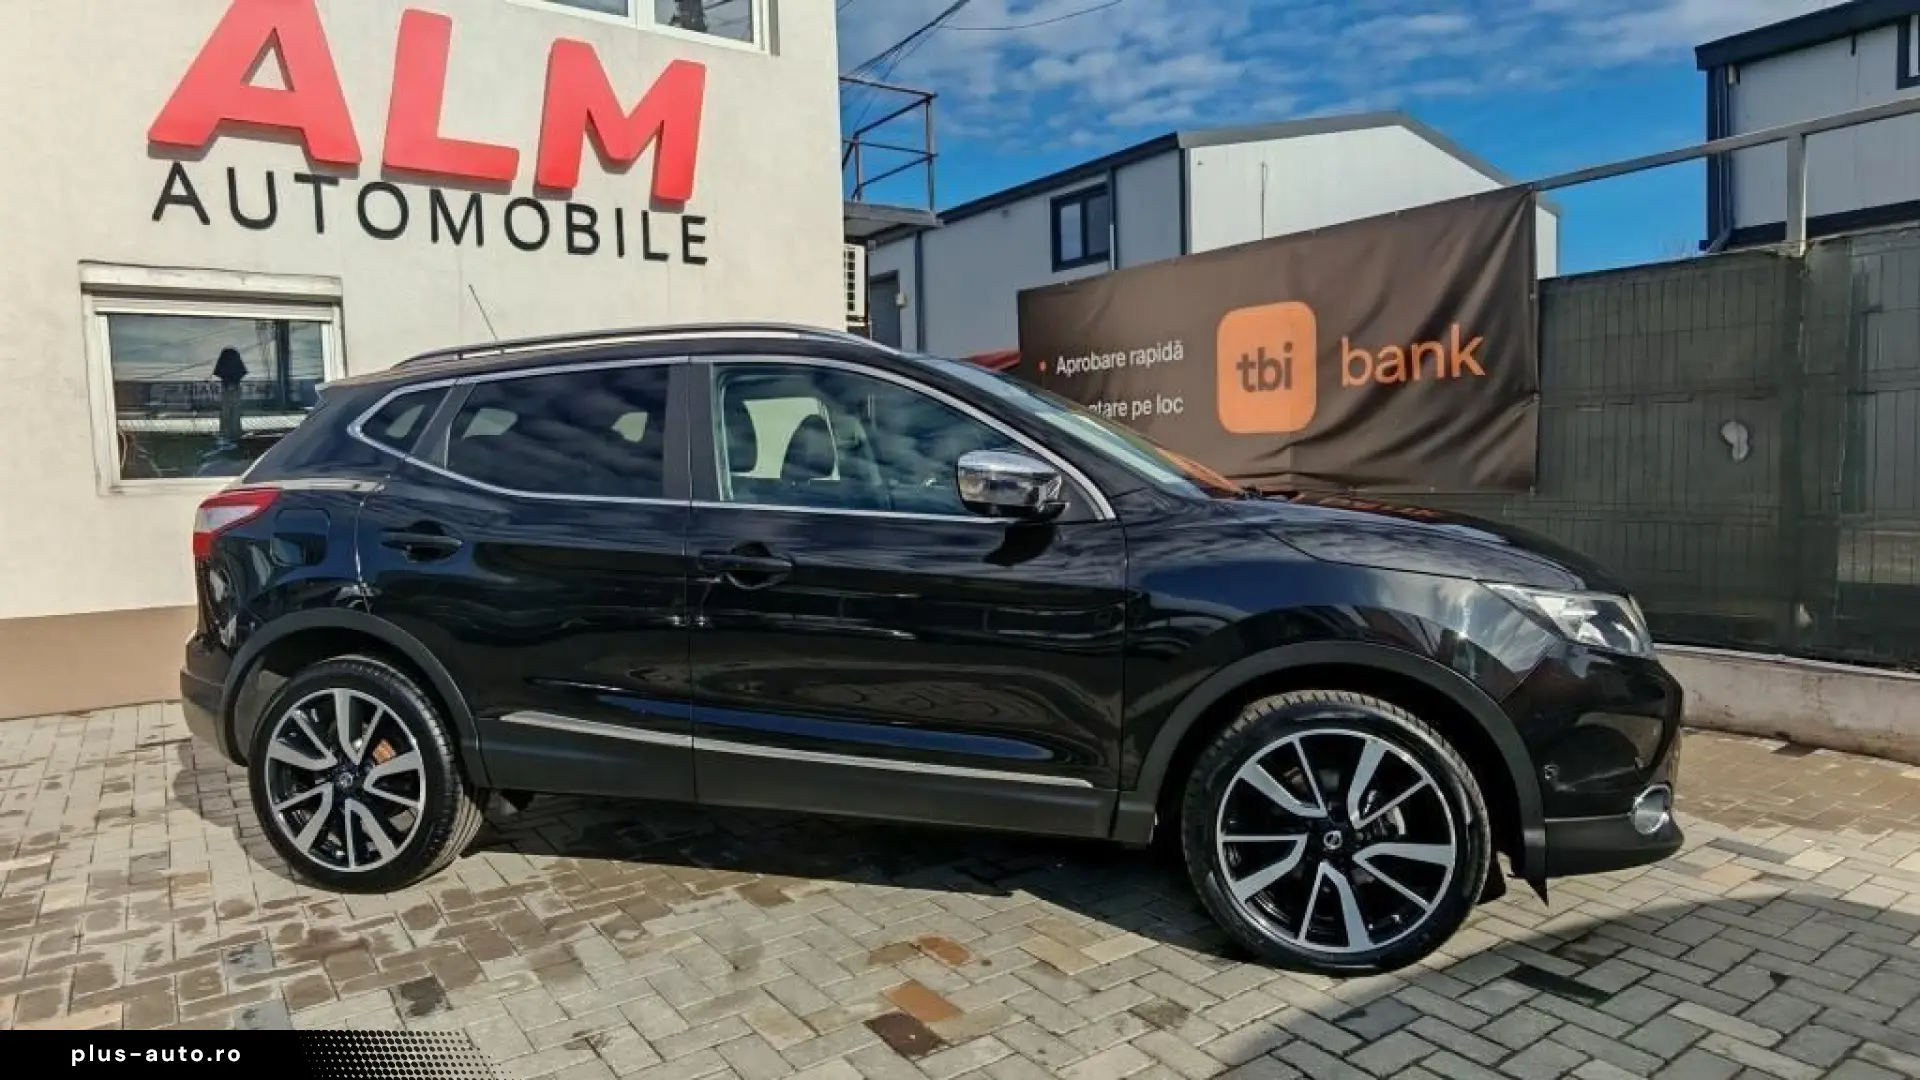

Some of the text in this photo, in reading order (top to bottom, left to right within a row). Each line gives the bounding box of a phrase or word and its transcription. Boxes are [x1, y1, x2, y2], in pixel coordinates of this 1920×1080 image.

[148, 0, 706, 203] ALM
[152, 161, 708, 266] AUTOMOBILE
[1056, 339, 1184, 378] Aprobare rapidă
[1236, 323, 1486, 393] tbi bank
[1131, 399, 1152, 421] pe
[1156, 393, 1184, 415] loc
